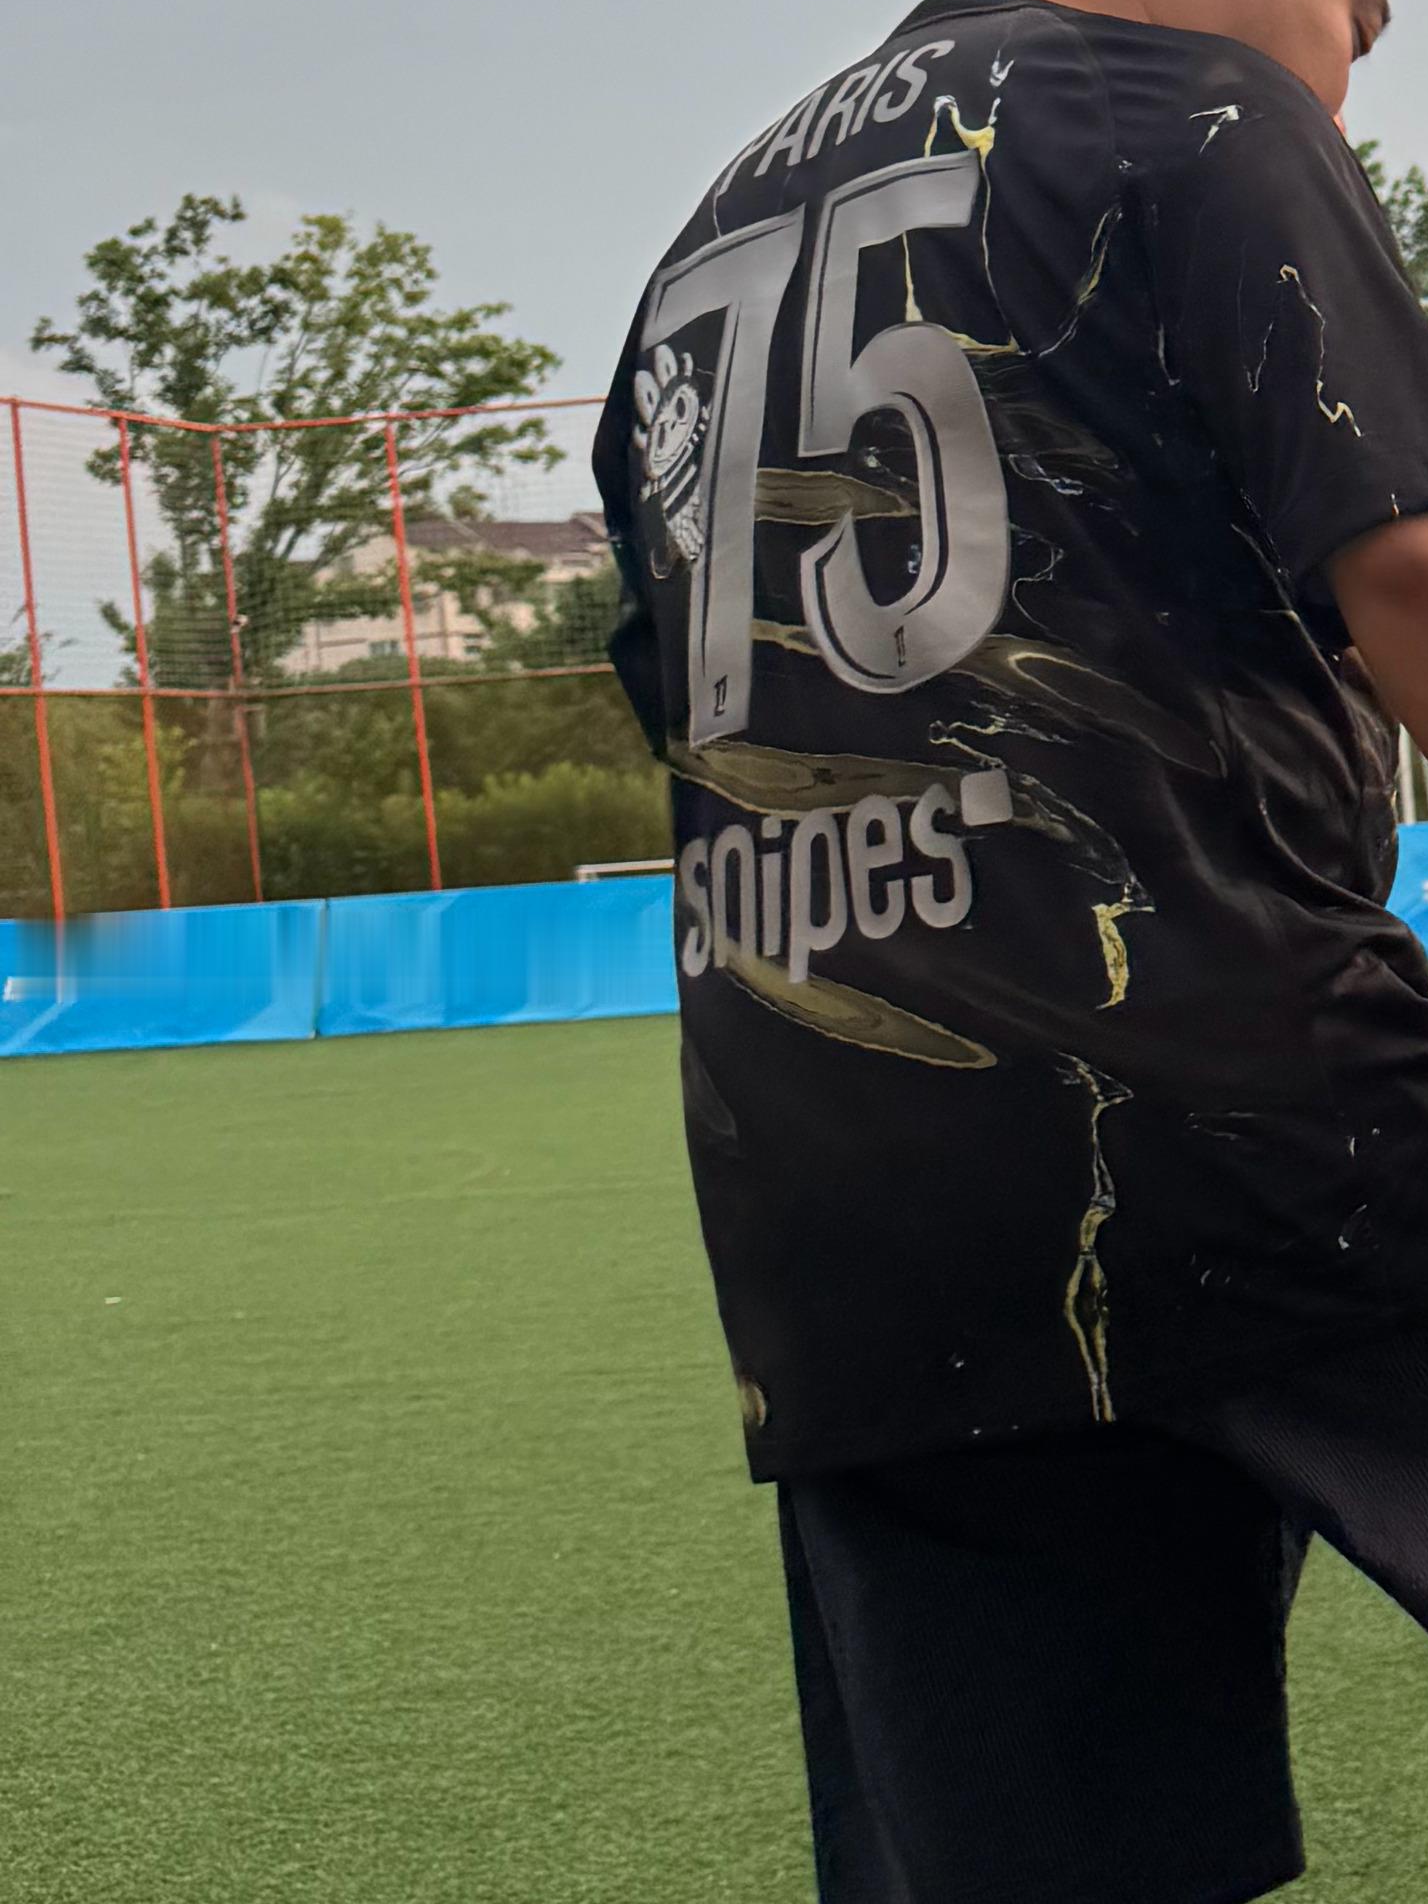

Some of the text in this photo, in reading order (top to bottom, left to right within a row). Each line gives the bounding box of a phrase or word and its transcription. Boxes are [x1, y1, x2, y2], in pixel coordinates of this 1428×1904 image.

[715, 39, 955, 195] PARIS
[641, 150, 1010, 747] 75
[680, 783, 973, 984] snipes
